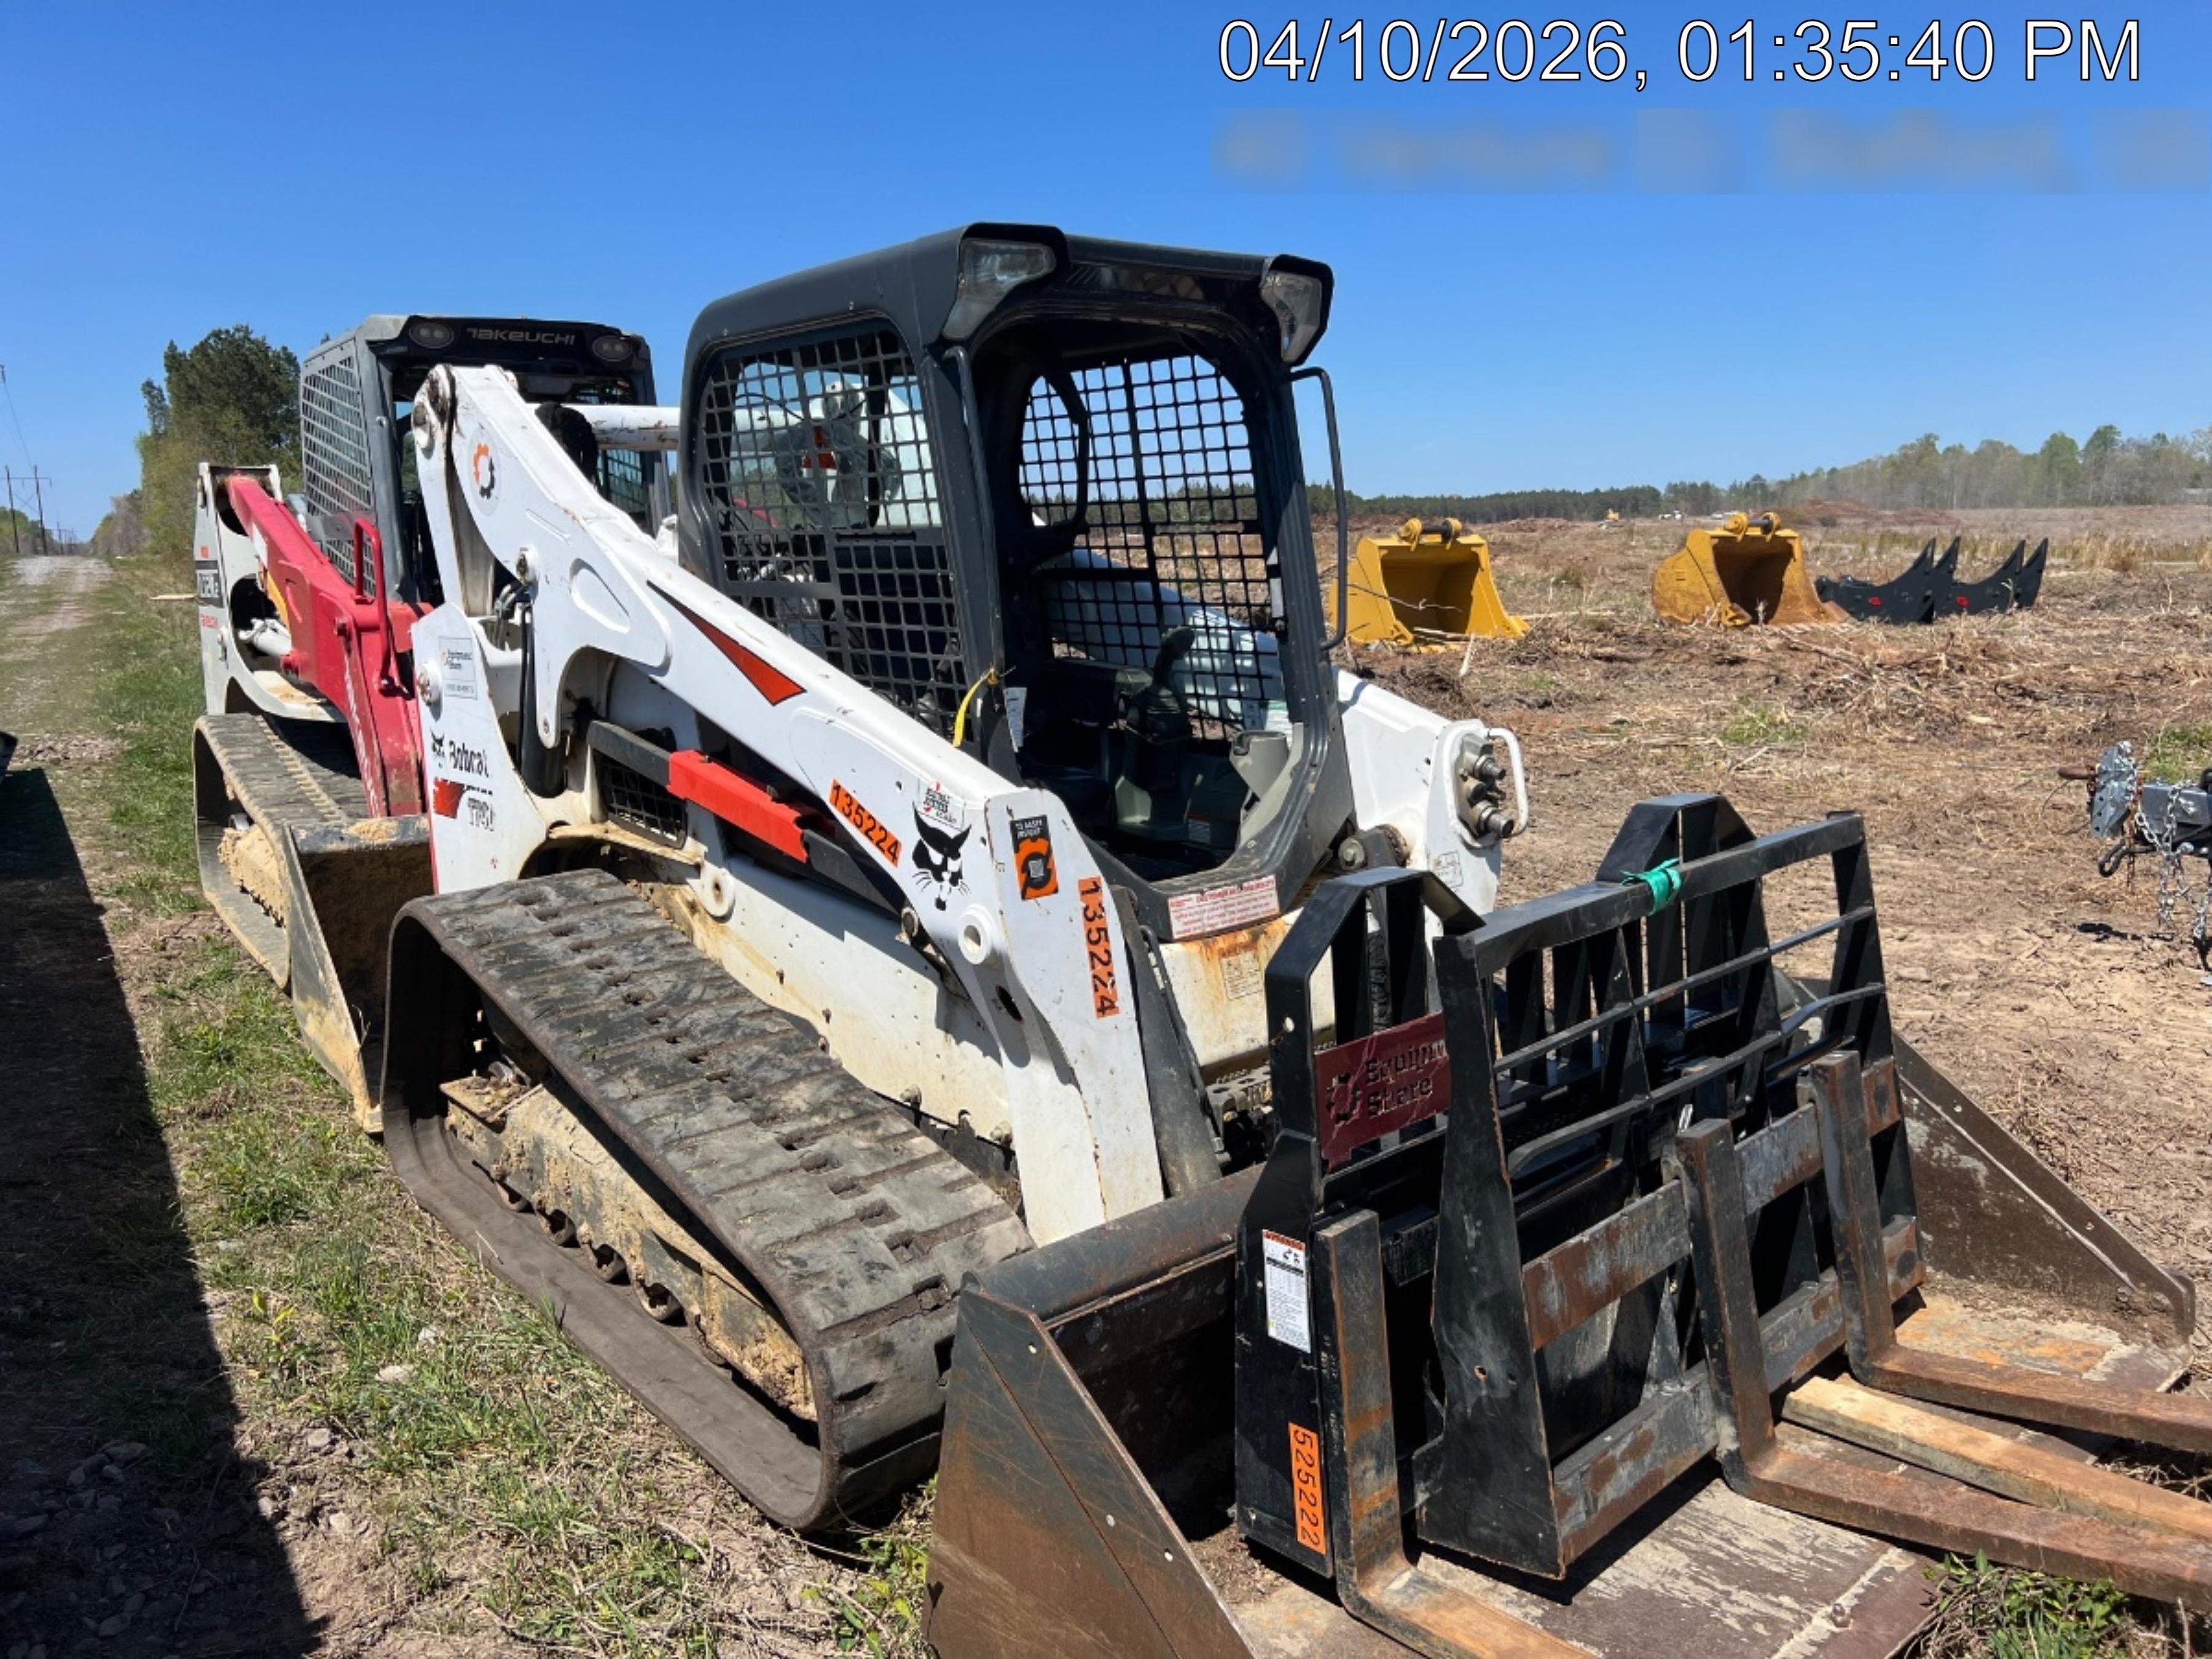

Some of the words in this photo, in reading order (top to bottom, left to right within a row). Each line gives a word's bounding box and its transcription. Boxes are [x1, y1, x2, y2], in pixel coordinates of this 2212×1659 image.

[466, 328, 576, 345] TAKEUCHI
[833, 785, 899, 863] 135224
[1082, 880, 1116, 1017] 135224
[1367, 1077, 1433, 1119] Share
[1293, 1430, 1320, 1547] 525222
